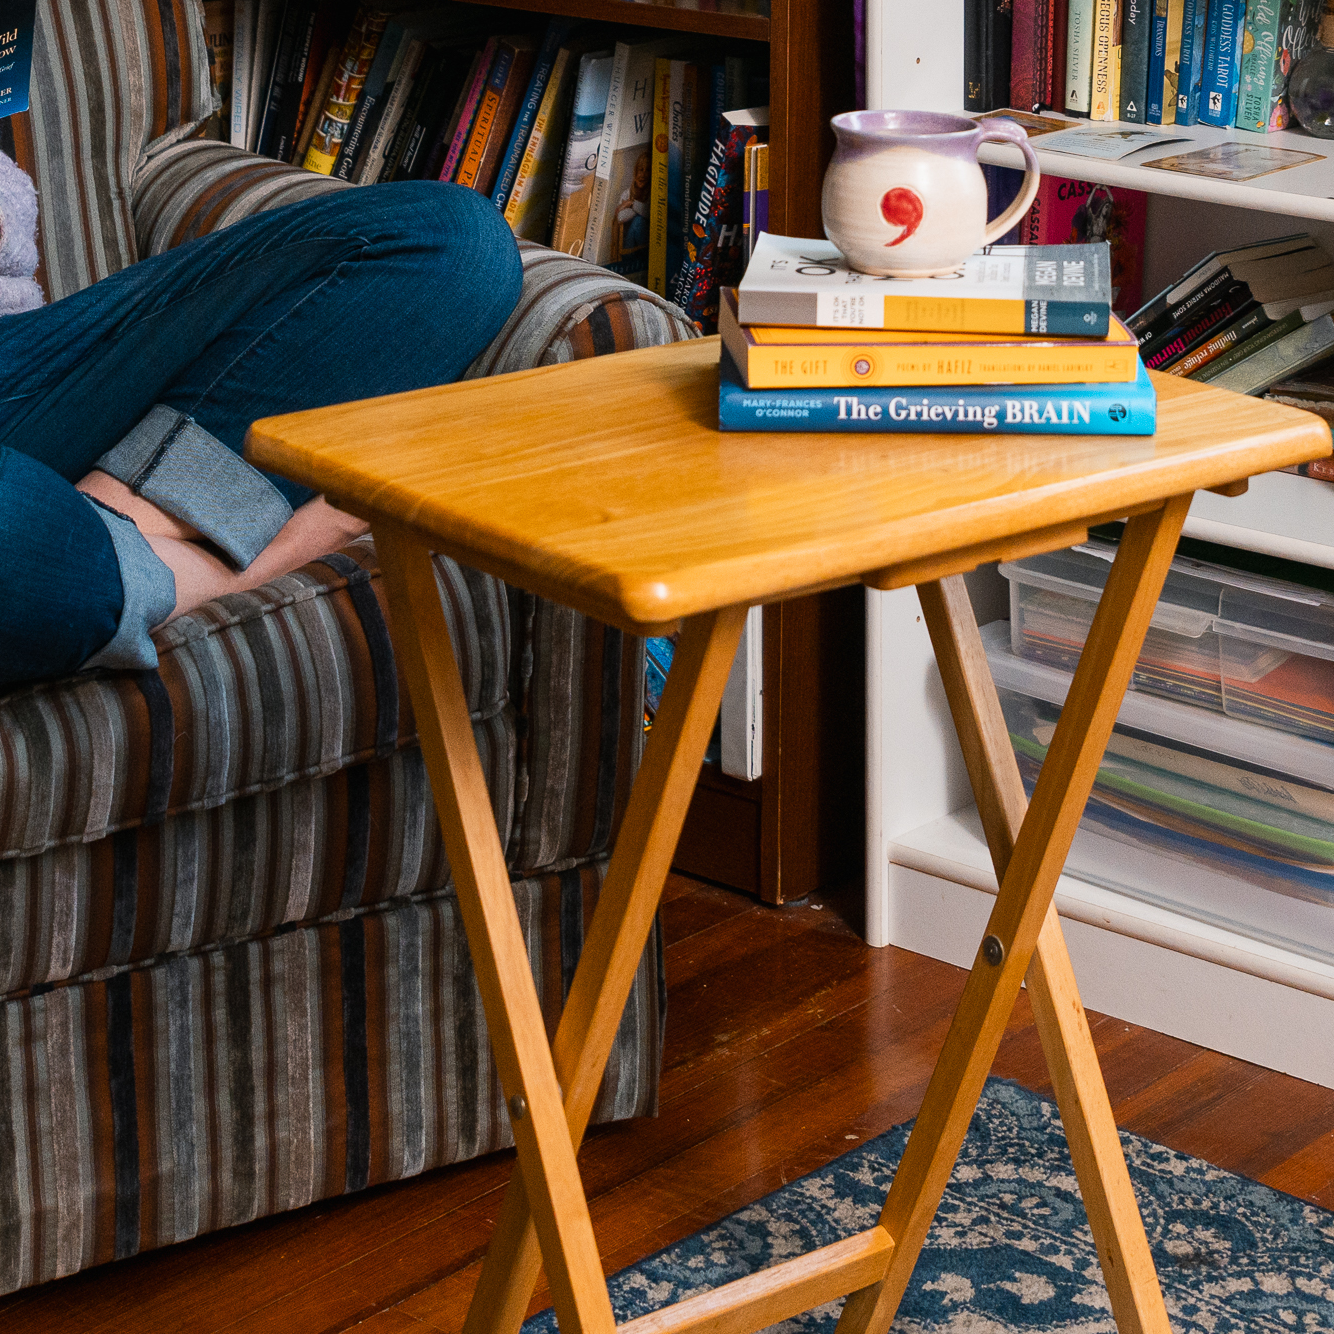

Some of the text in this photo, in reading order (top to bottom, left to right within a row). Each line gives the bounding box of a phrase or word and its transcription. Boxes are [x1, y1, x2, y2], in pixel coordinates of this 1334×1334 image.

[1222, 5, 1236, 57] GODDESS
[1097, 34, 1110, 94] OPENNESS
[1218, 60, 1230, 88] TAROT
[1254, 31, 1274, 90] Offering
[527, 63, 550, 110] TREATING
[338, 96, 375, 180] Encountering God
[504, 122, 529, 192] TRAUMATIZED
[695, 139, 725, 227] HAGITUDE
[795, 255, 839, 276] OK
[1039, 300, 1047, 333] DEVINE
[774, 359, 972, 375] THE GIFT HAFIZ
[1184, 330, 1237, 370] finding refuge
[742, 399, 823, 408] MARY-FRANCES
[755, 408, 809, 418] O'CONNOR
[833, 396, 1092, 429] The Grieving BRAIN
